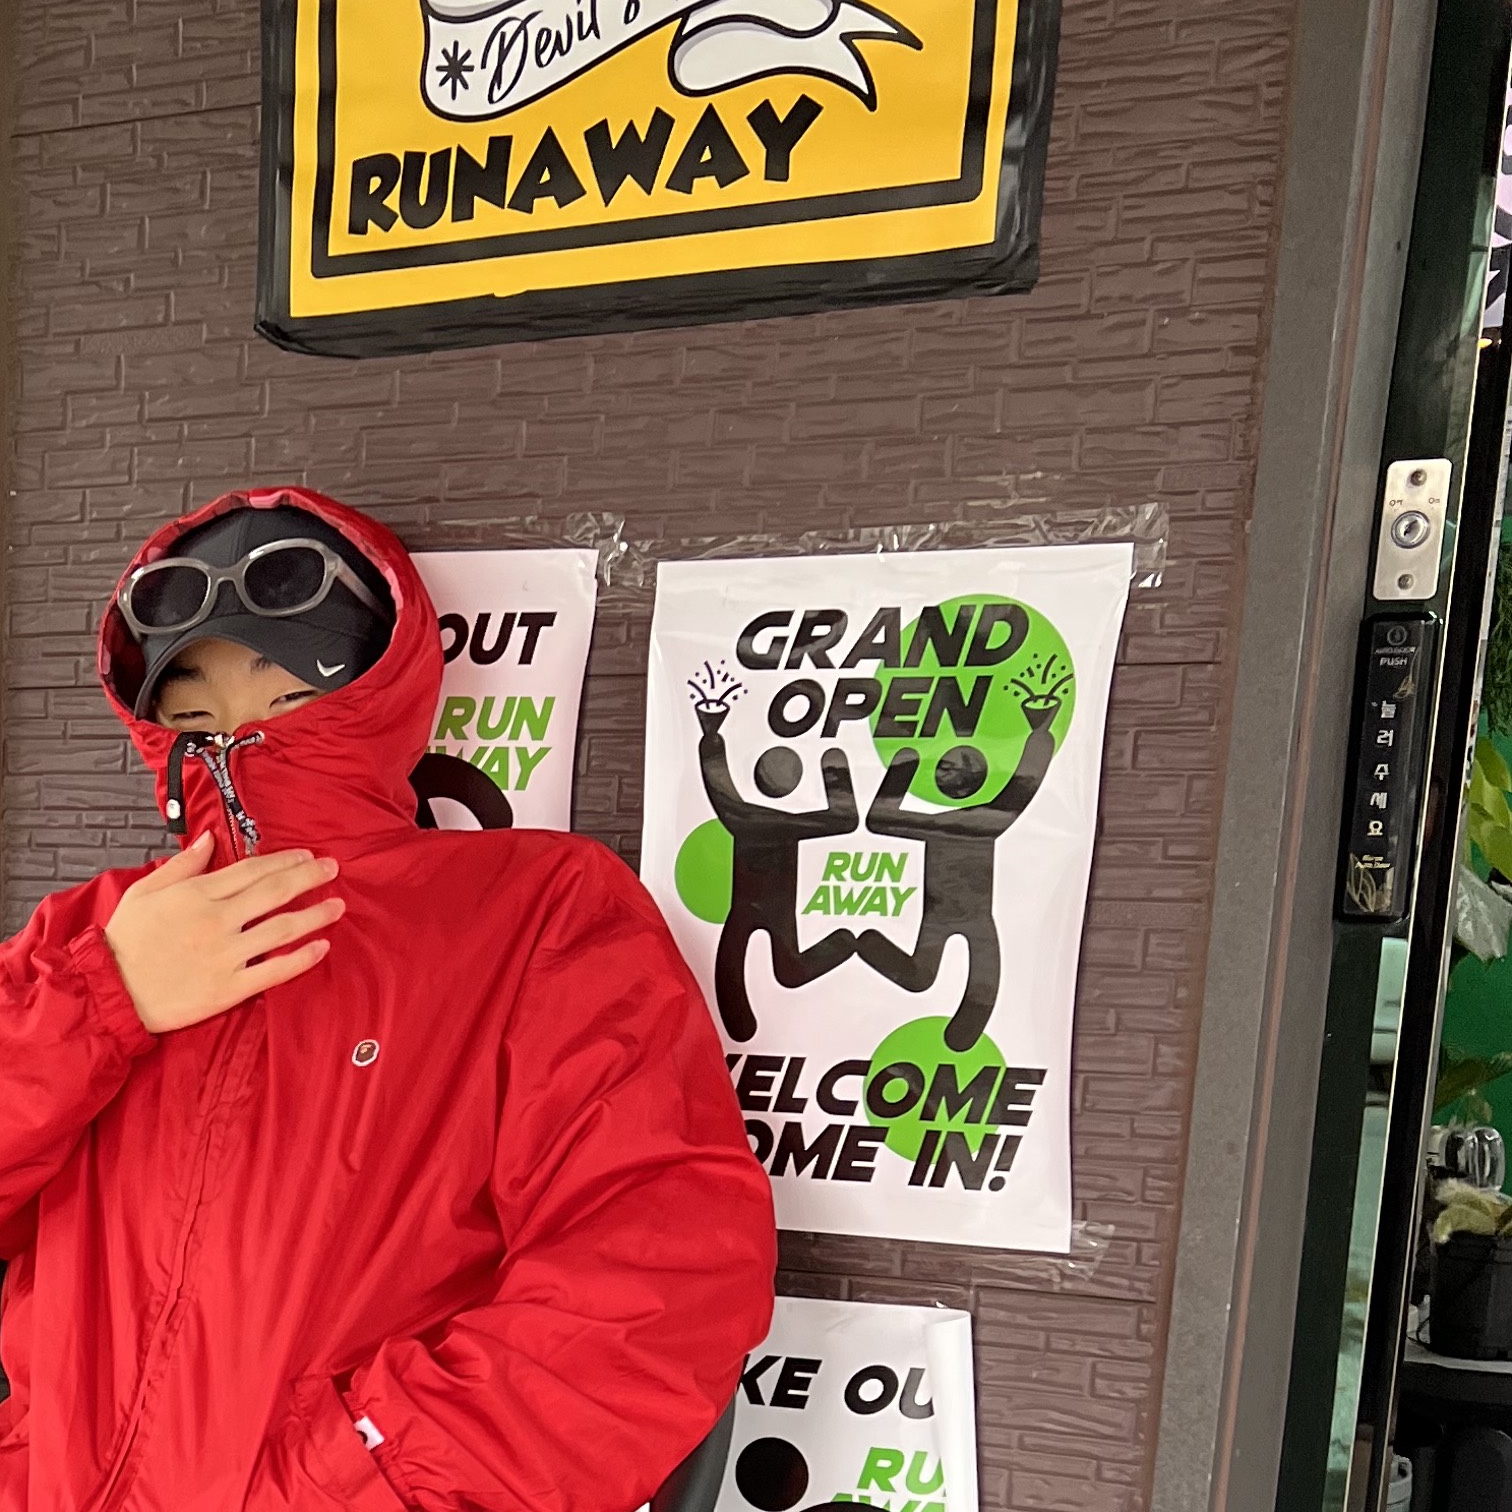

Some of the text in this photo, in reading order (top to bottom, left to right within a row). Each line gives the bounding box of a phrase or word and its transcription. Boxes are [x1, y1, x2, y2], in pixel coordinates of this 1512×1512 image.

[348, 95, 823, 236] RUNAWAY
[736, 604, 1030, 670] GRAND
[434, 696, 556, 741] RUN
[768, 675, 994, 738] OPEN
[822, 852, 909, 882] RUN
[801, 885, 918, 916] AWAY
[908, 1129, 1024, 1192] IN!
